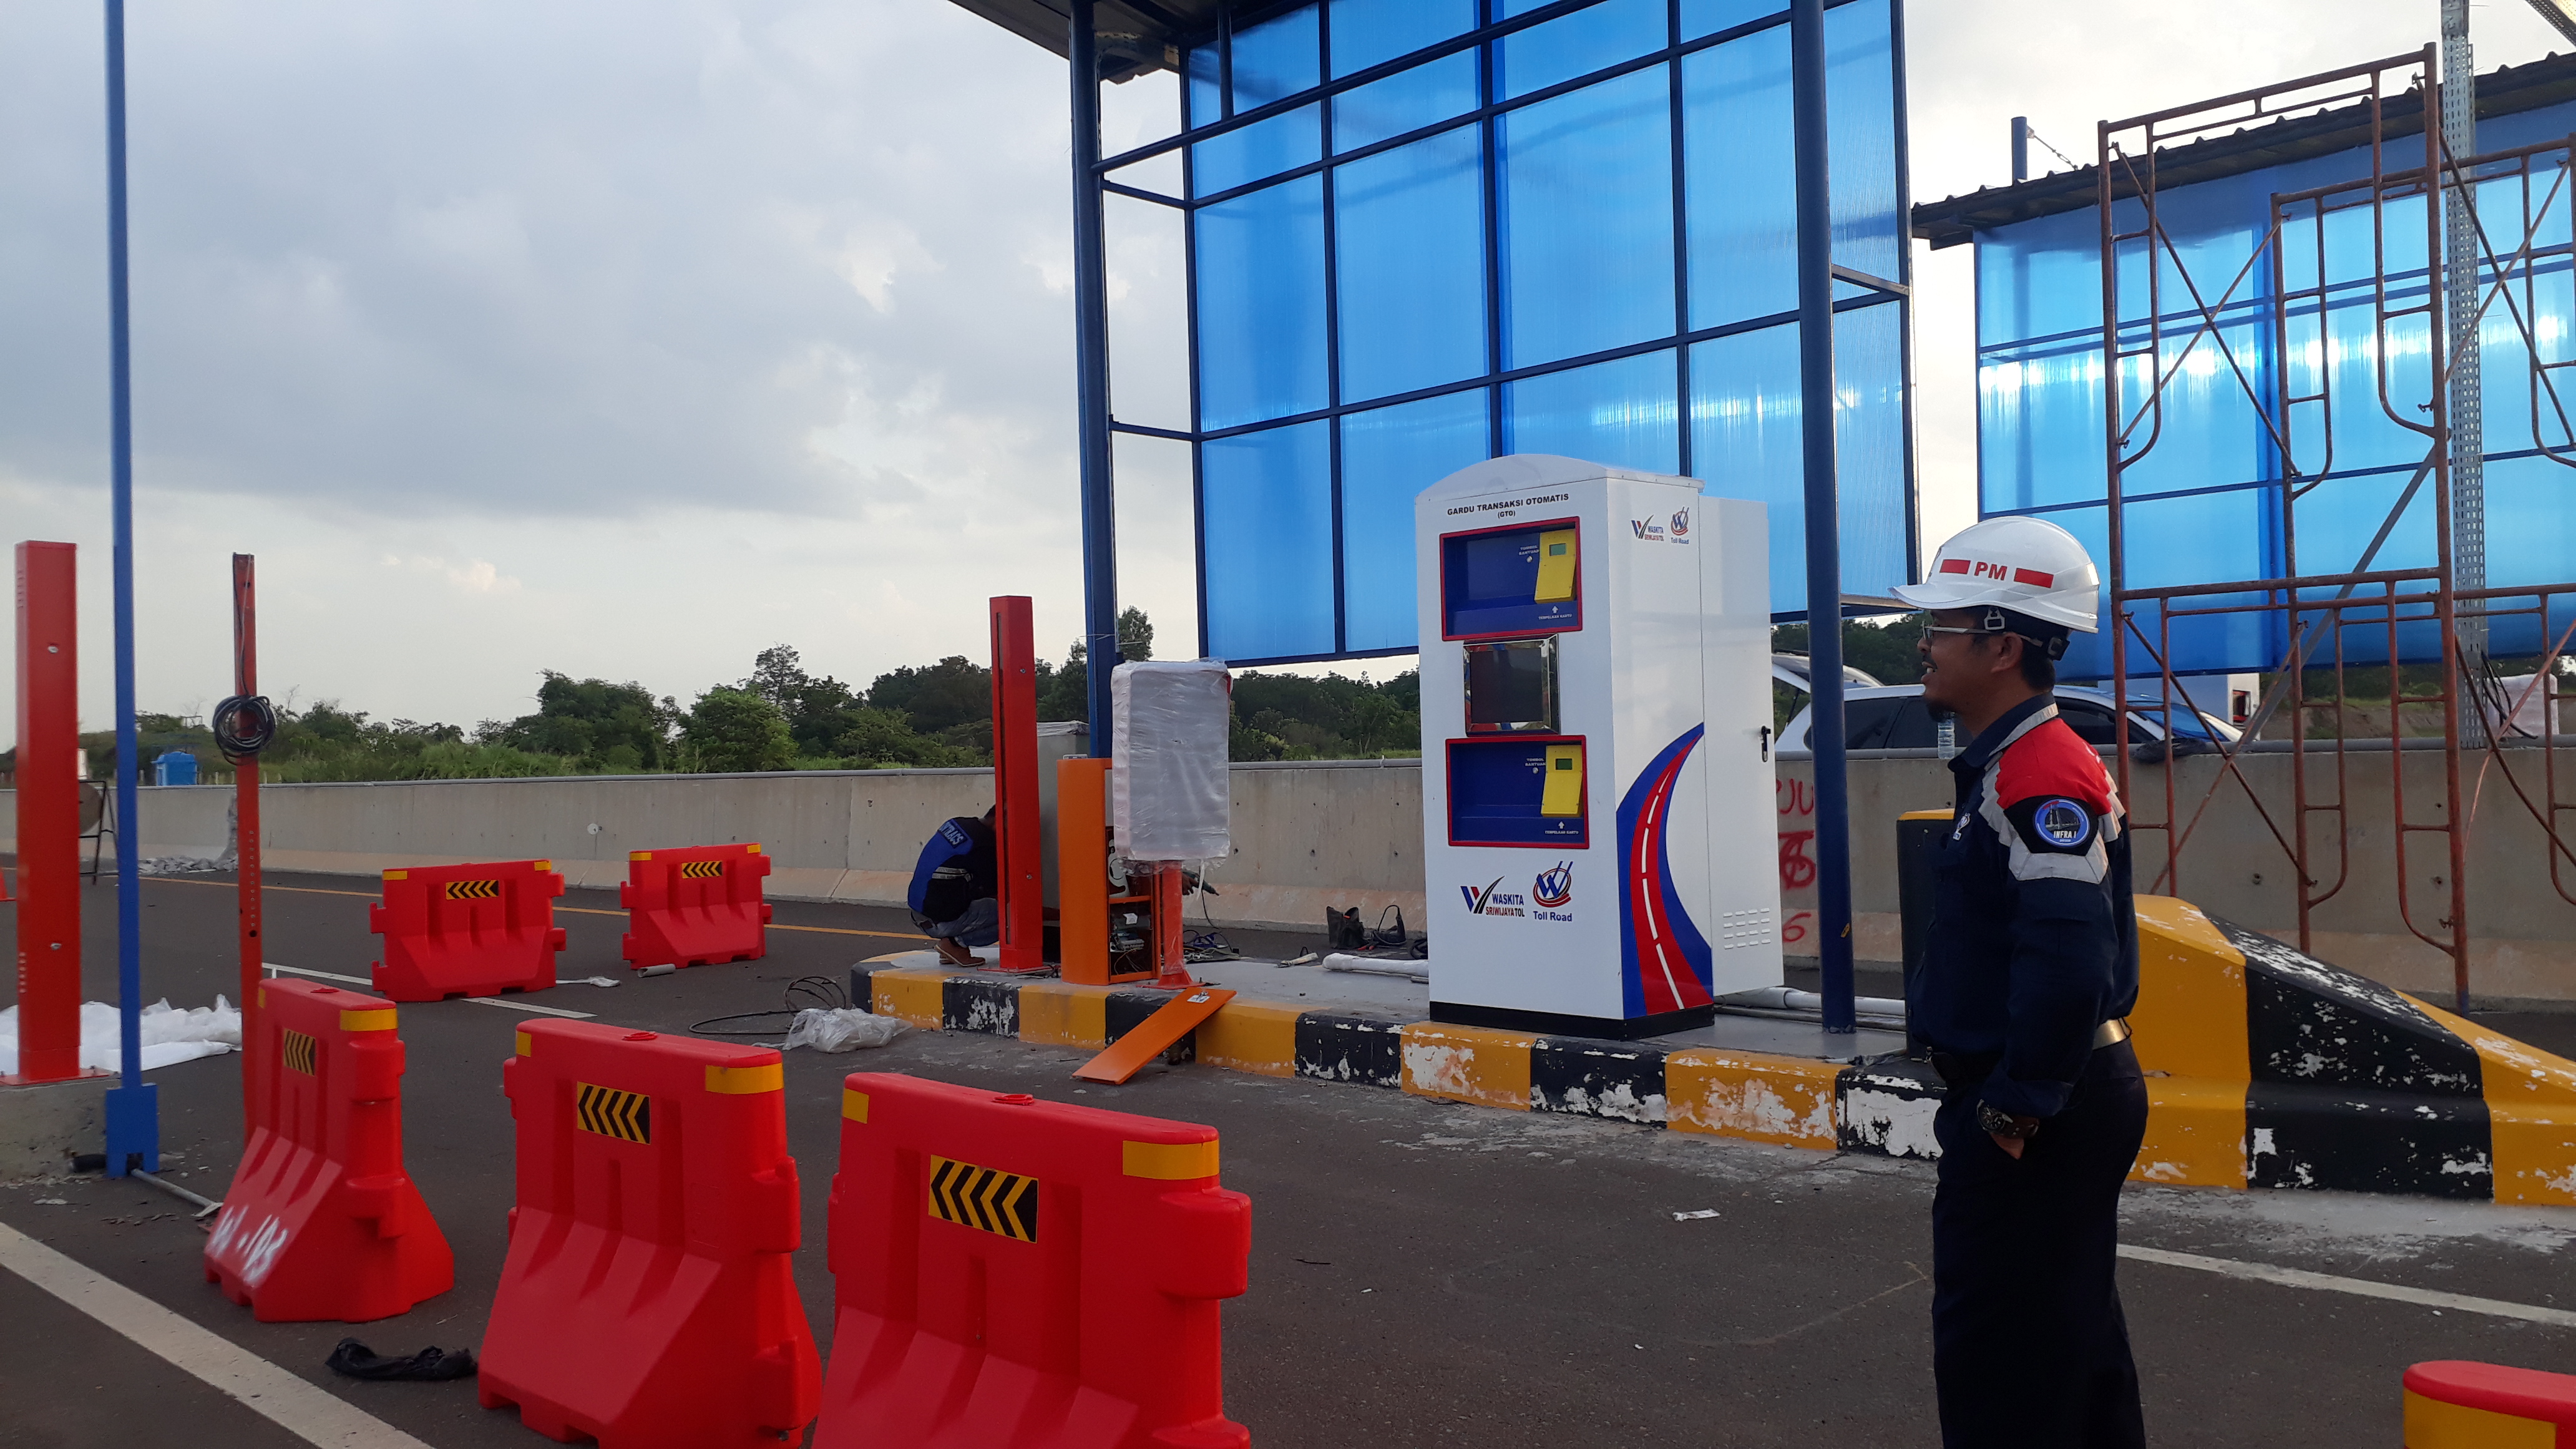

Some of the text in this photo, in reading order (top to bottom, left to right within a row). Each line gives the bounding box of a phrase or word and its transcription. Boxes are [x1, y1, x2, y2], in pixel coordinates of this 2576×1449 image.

[1447, 494, 1569, 515] GARDU TRANSAKSI OTOMATIS
[1498, 510, 1516, 519] (GTO)
[1974, 561, 2008, 581] PM
[2053, 831, 2072, 839] INFRA
[1491, 893, 1525, 905] WASKITA
[1533, 910, 1573, 922] Toll Road
